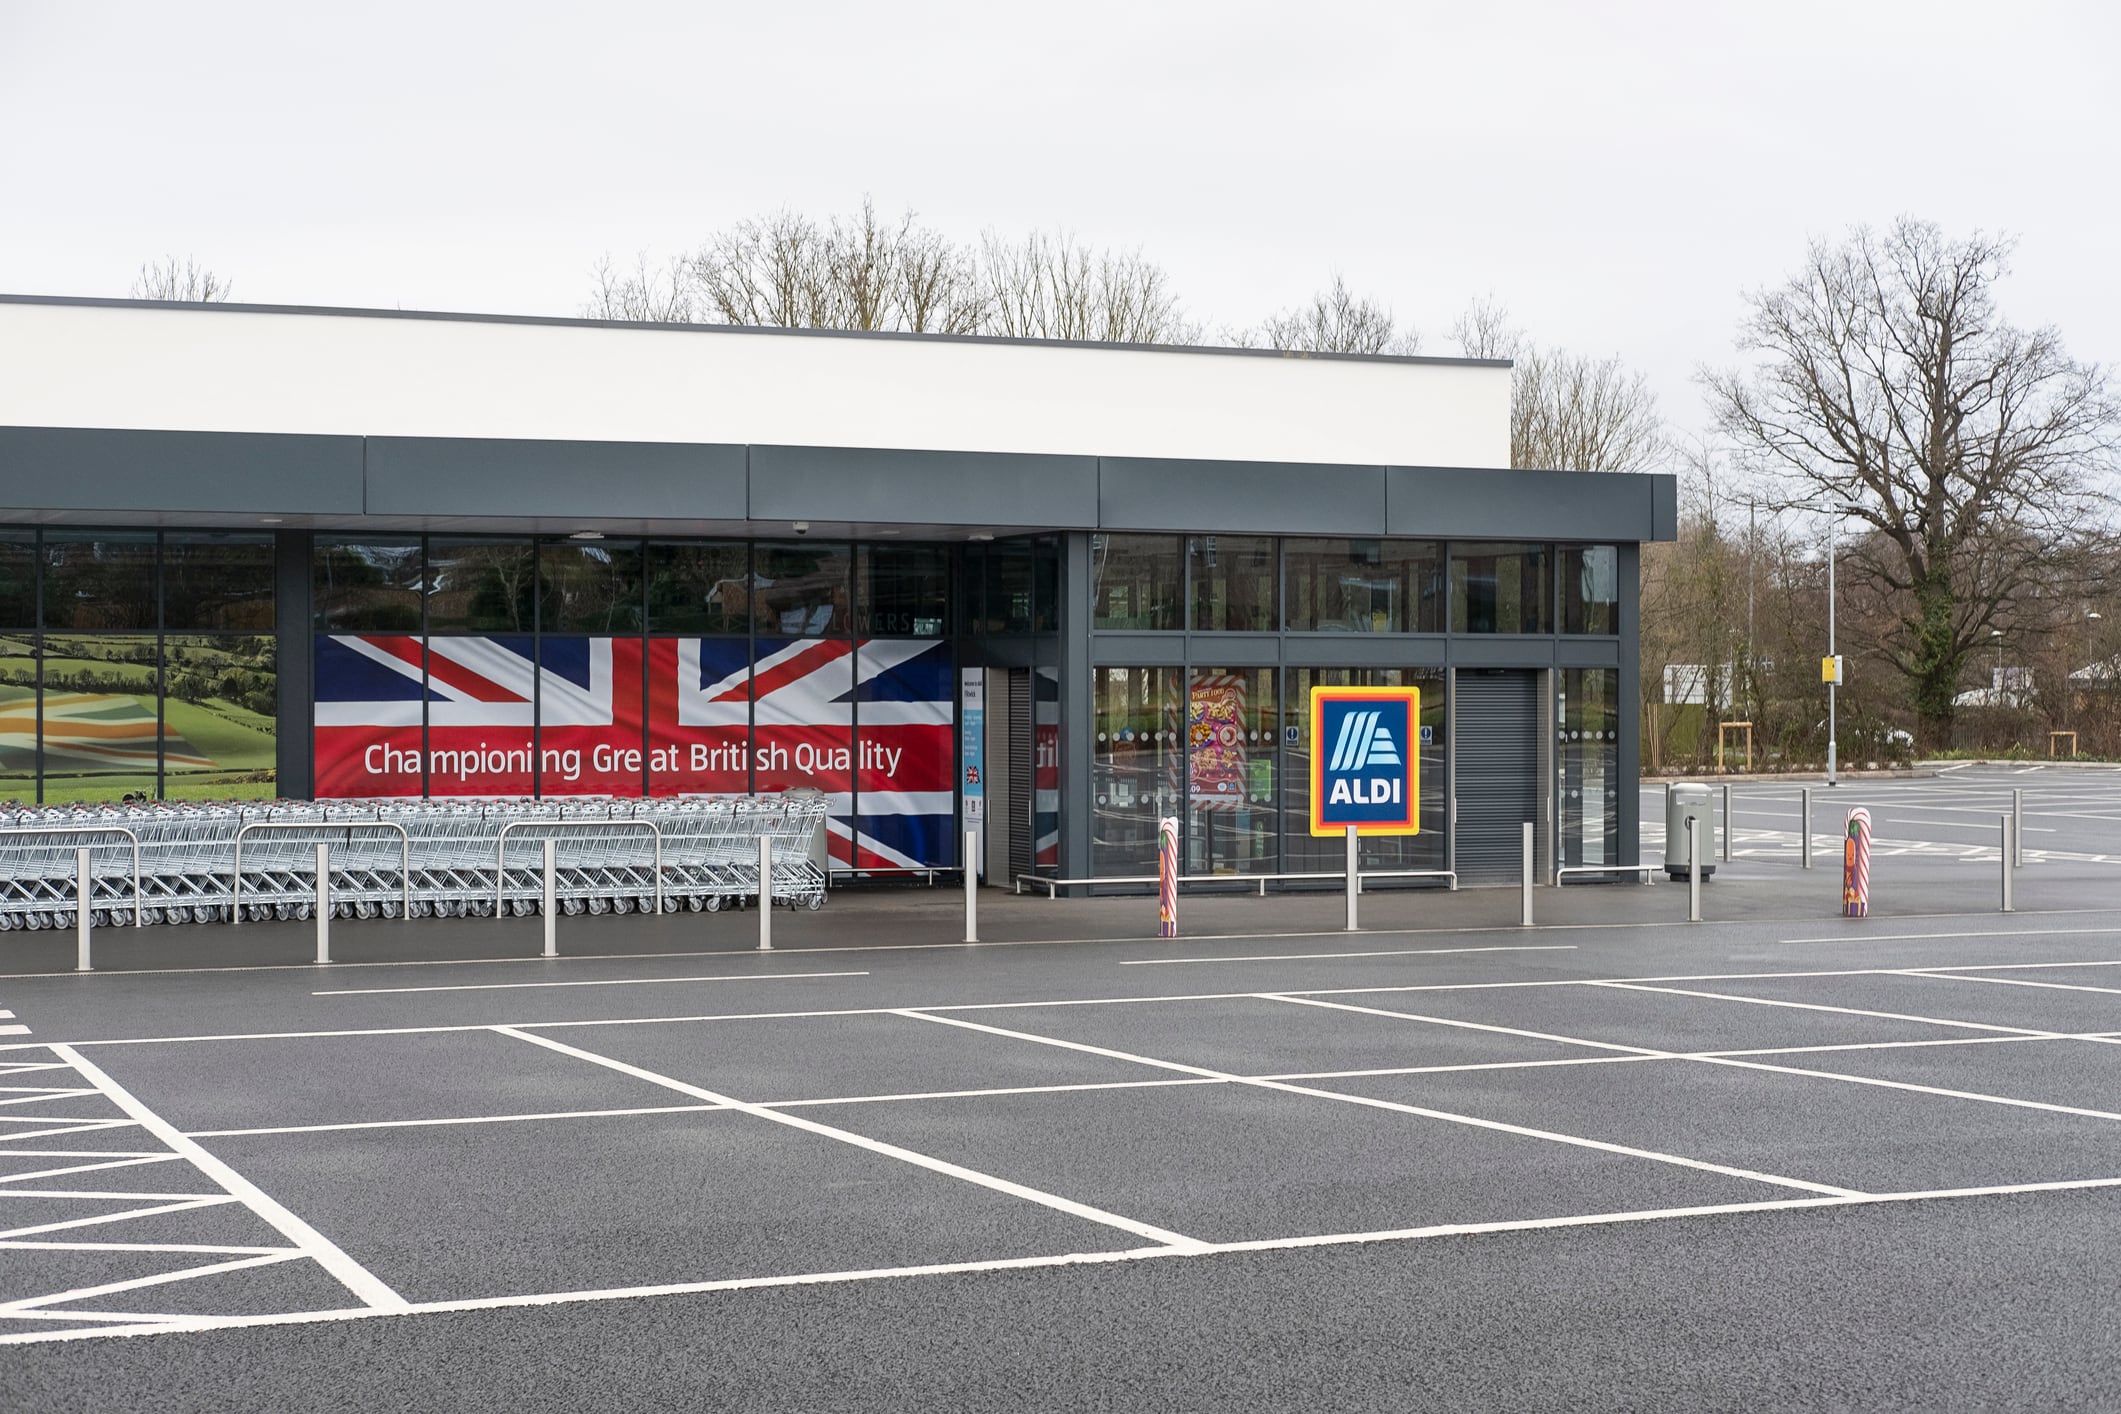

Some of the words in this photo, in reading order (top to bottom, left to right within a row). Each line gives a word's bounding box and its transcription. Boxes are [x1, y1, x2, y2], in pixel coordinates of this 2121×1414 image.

[365, 742, 580, 781] Championing
[593, 743, 679, 773] Great
[691, 741, 787, 772] British
[795, 740, 902, 777] Quality
[1329, 778, 1401, 804] ALDI
